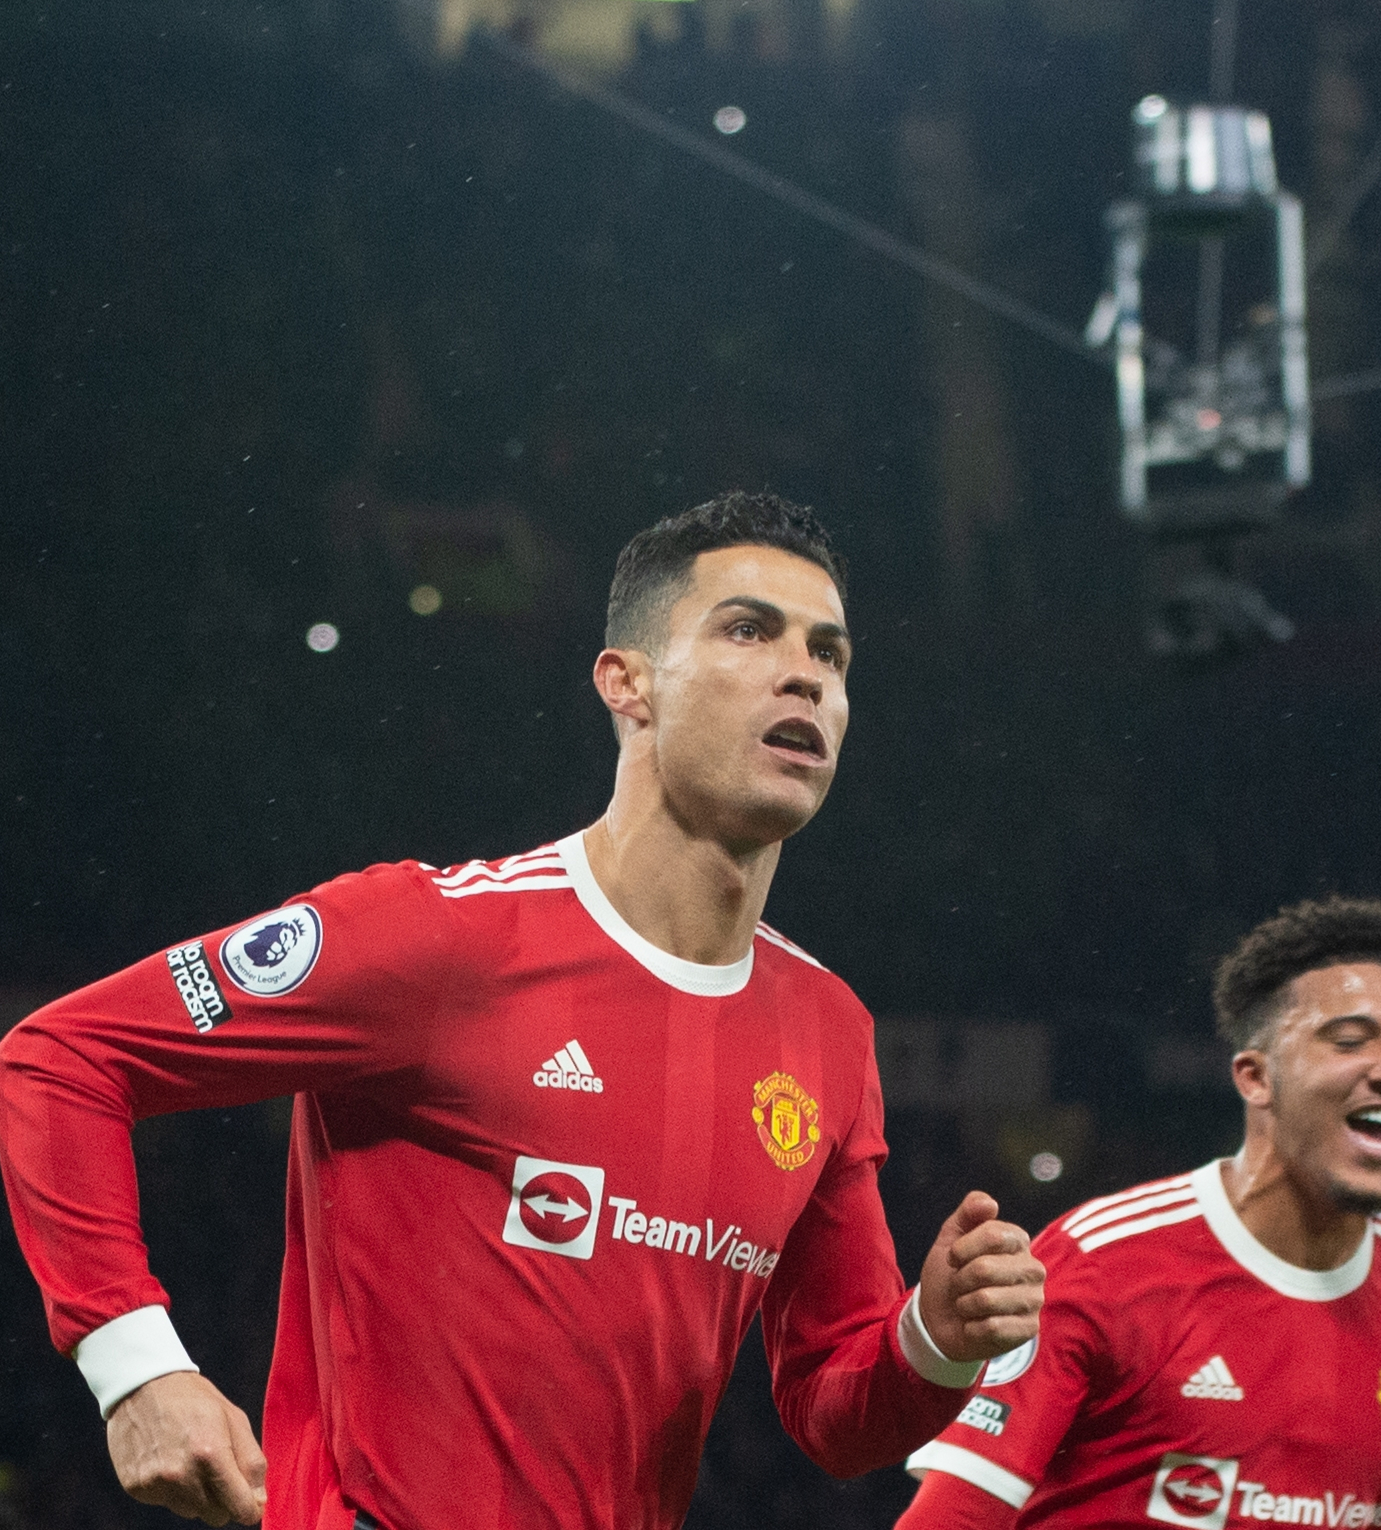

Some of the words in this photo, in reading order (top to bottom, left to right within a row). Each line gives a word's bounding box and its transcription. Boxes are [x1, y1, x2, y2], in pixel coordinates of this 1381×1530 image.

[232, 954, 257, 981] Premier
[257, 970, 287, 985] League
[172, 966, 214, 1034] racism
[188, 959, 224, 1017] room
[532, 1069, 604, 1094] adidas
[766, 1140, 805, 1165] UNITED
